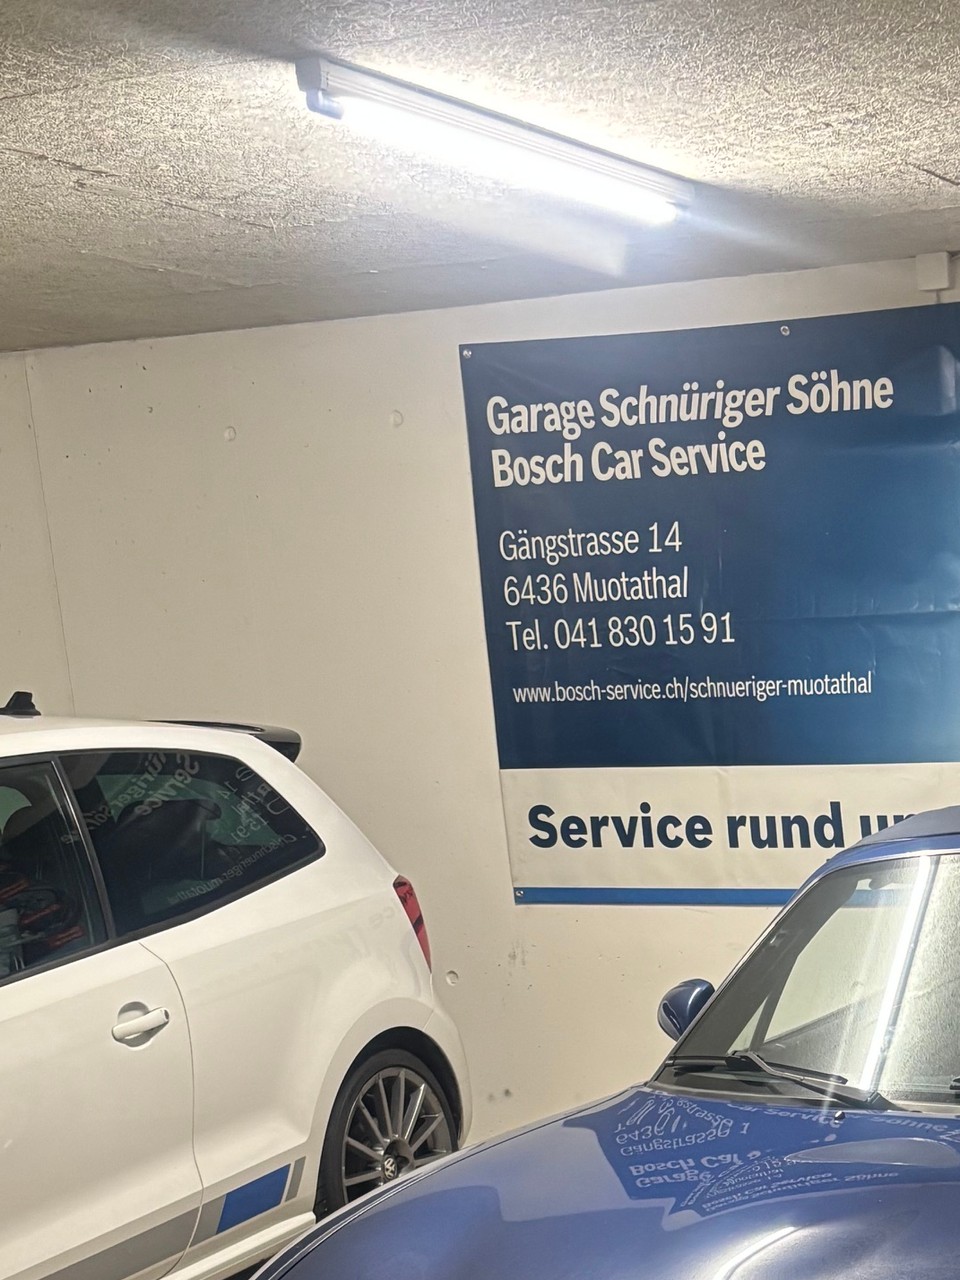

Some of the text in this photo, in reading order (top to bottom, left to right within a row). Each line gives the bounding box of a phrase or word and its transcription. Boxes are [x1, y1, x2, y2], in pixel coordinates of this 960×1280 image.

[486, 368, 894, 441] Garage Schnüriger Söhne
[490, 430, 766, 488] Bosch Car Service
[499, 520, 683, 566] Gängstrasse 14
[503, 565, 689, 606] 6436 Muotathal
[505, 611, 736, 651] Tel. 041 830 15 91
[512, 672, 872, 703] www.bosch-service.ch/schnueriger-muotathal
[528, 801, 713, 849] Service
[727, 801, 845, 849] rund
